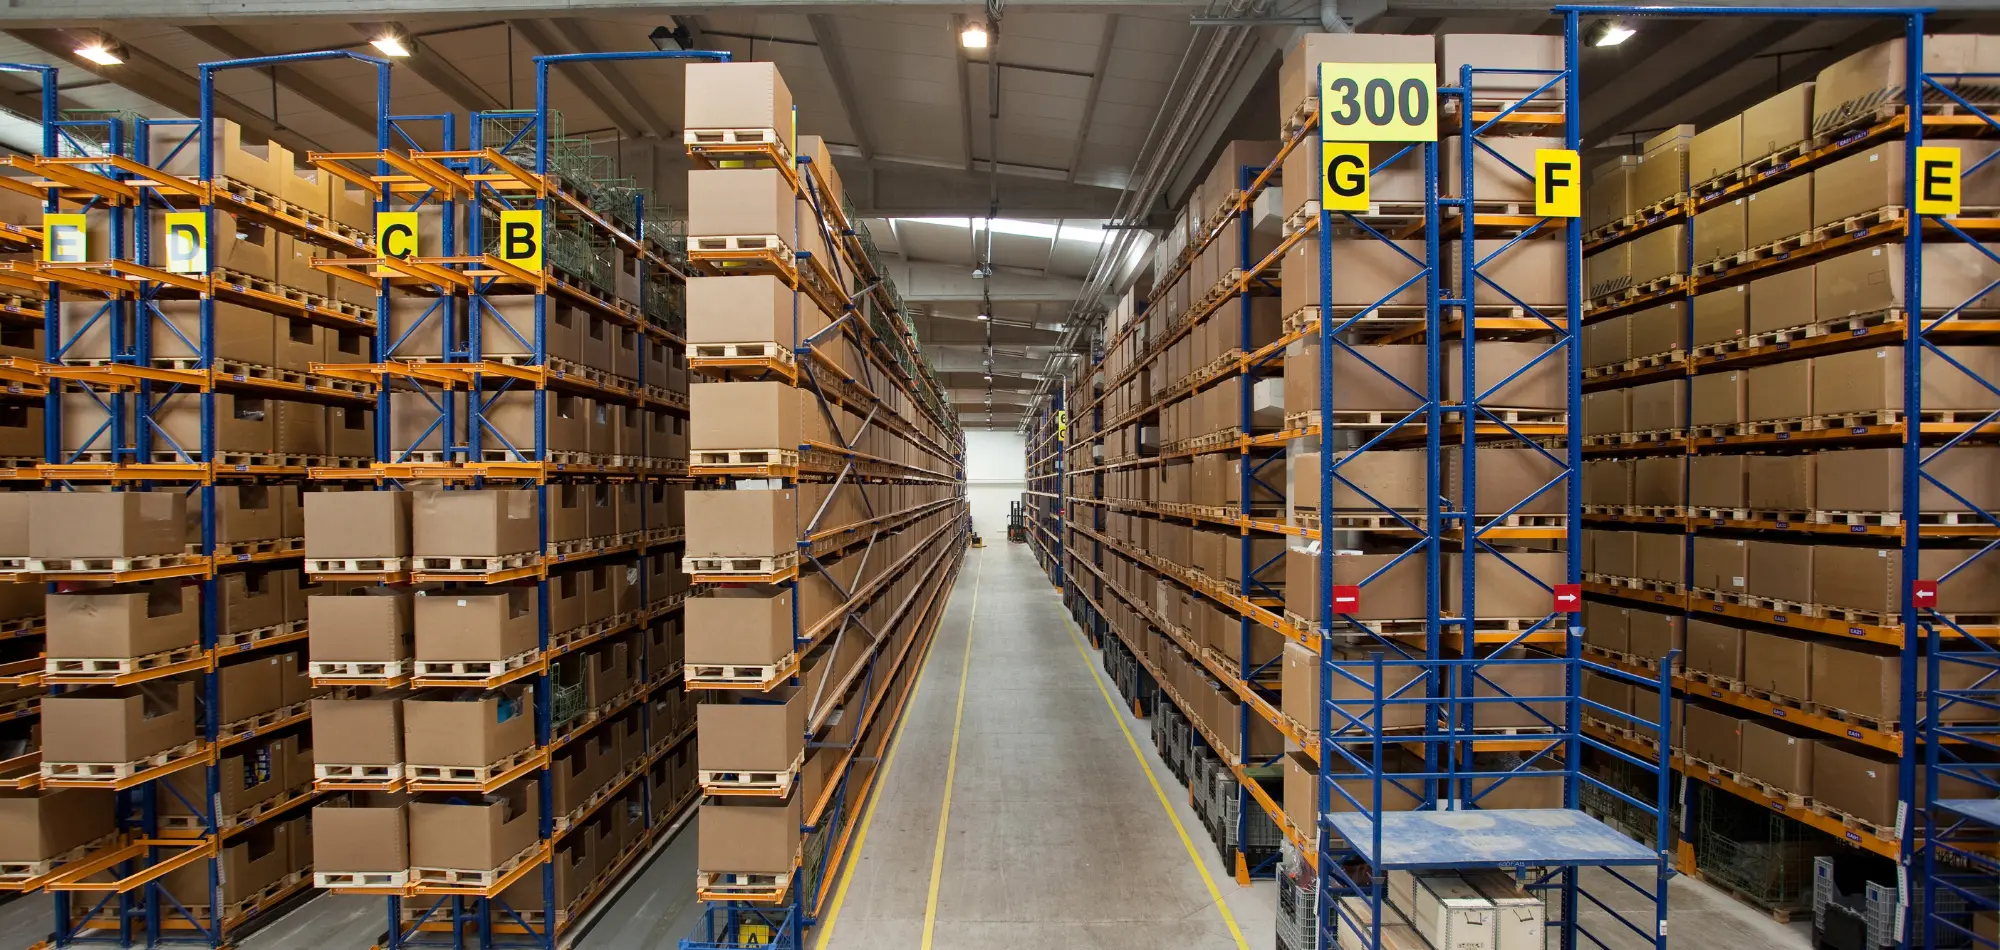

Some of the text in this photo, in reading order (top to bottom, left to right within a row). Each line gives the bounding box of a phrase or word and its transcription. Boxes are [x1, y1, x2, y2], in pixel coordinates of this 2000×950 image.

[1330, 77, 1430, 126] 300
[1327, 154, 1366, 197] G
[1545, 162, 1572, 204] F
[1924, 160, 1953, 202] E
[50, 224, 79, 262] E
[170, 224, 200, 261] D
[381, 223, 412, 260] C
[505, 222, 537, 260] B
[745, 932, 760, 948] A
